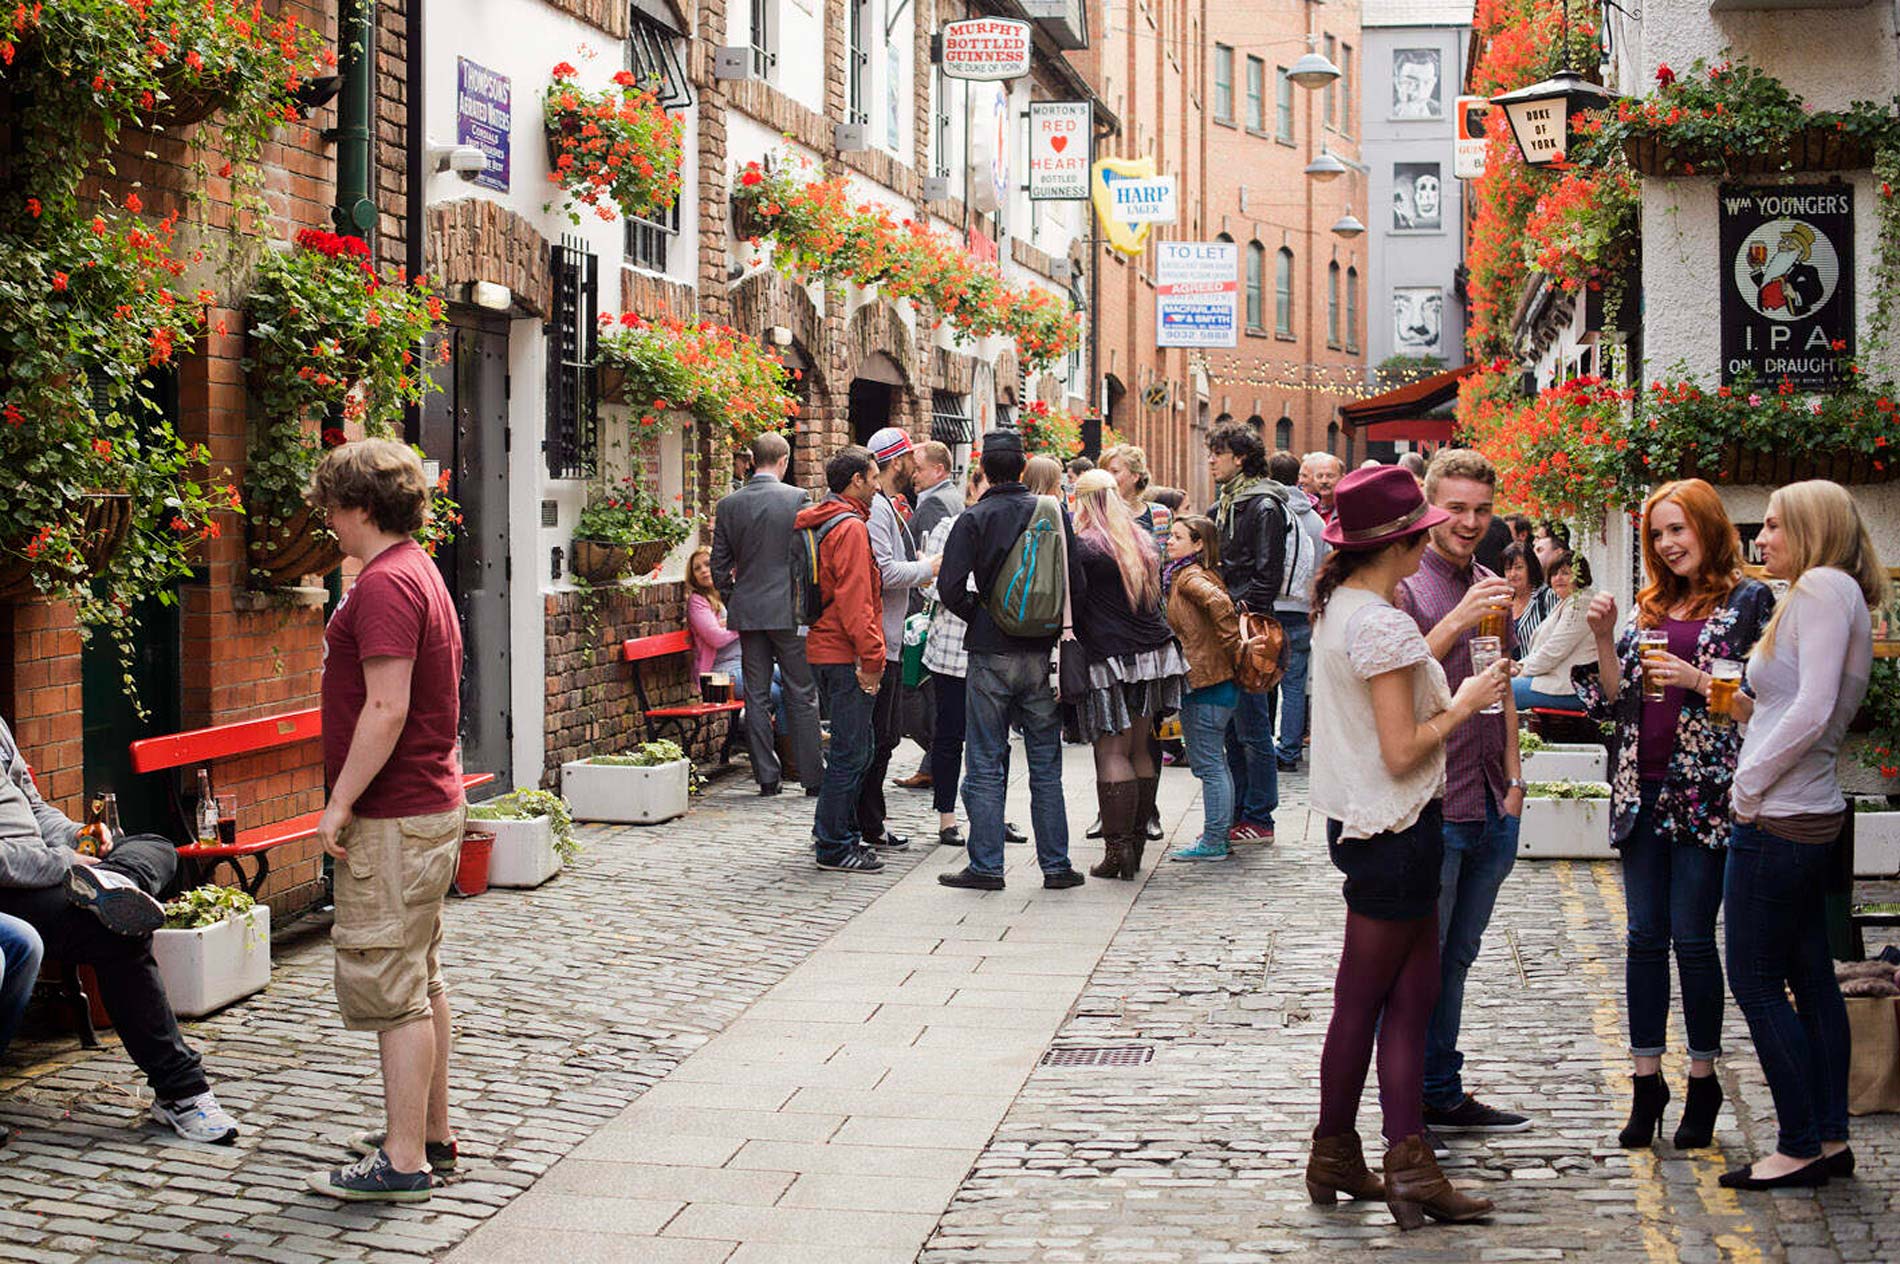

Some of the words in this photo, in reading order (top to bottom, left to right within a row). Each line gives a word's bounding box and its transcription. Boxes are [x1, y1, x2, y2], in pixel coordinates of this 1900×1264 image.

[949, 23, 1023, 36] MURPHY
[946, 38, 1025, 49] BOTTLED
[945, 50, 1024, 62] GUINNESS
[964, 63, 986, 72] DUKE
[1033, 105, 1086, 115] MORTON'S
[1526, 109, 1551, 121] DUKE
[1042, 120, 1077, 132] RED
[1535, 125, 1547, 135] OF
[1530, 138, 1557, 150] YORK
[1031, 158, 1087, 170] HEART
[1041, 175, 1078, 184] BOTTLED
[1033, 185, 1087, 197] GUINNESS
[1117, 186, 1169, 203] HARP
[1127, 204, 1160, 214] LAGER
[1757, 193, 1849, 215] YOUNGER'S
[1168, 246, 1191, 258] TO
[1196, 247, 1227, 259] LET
[1171, 282, 1224, 294] AGREED
[1729, 359, 1753, 375] ON
